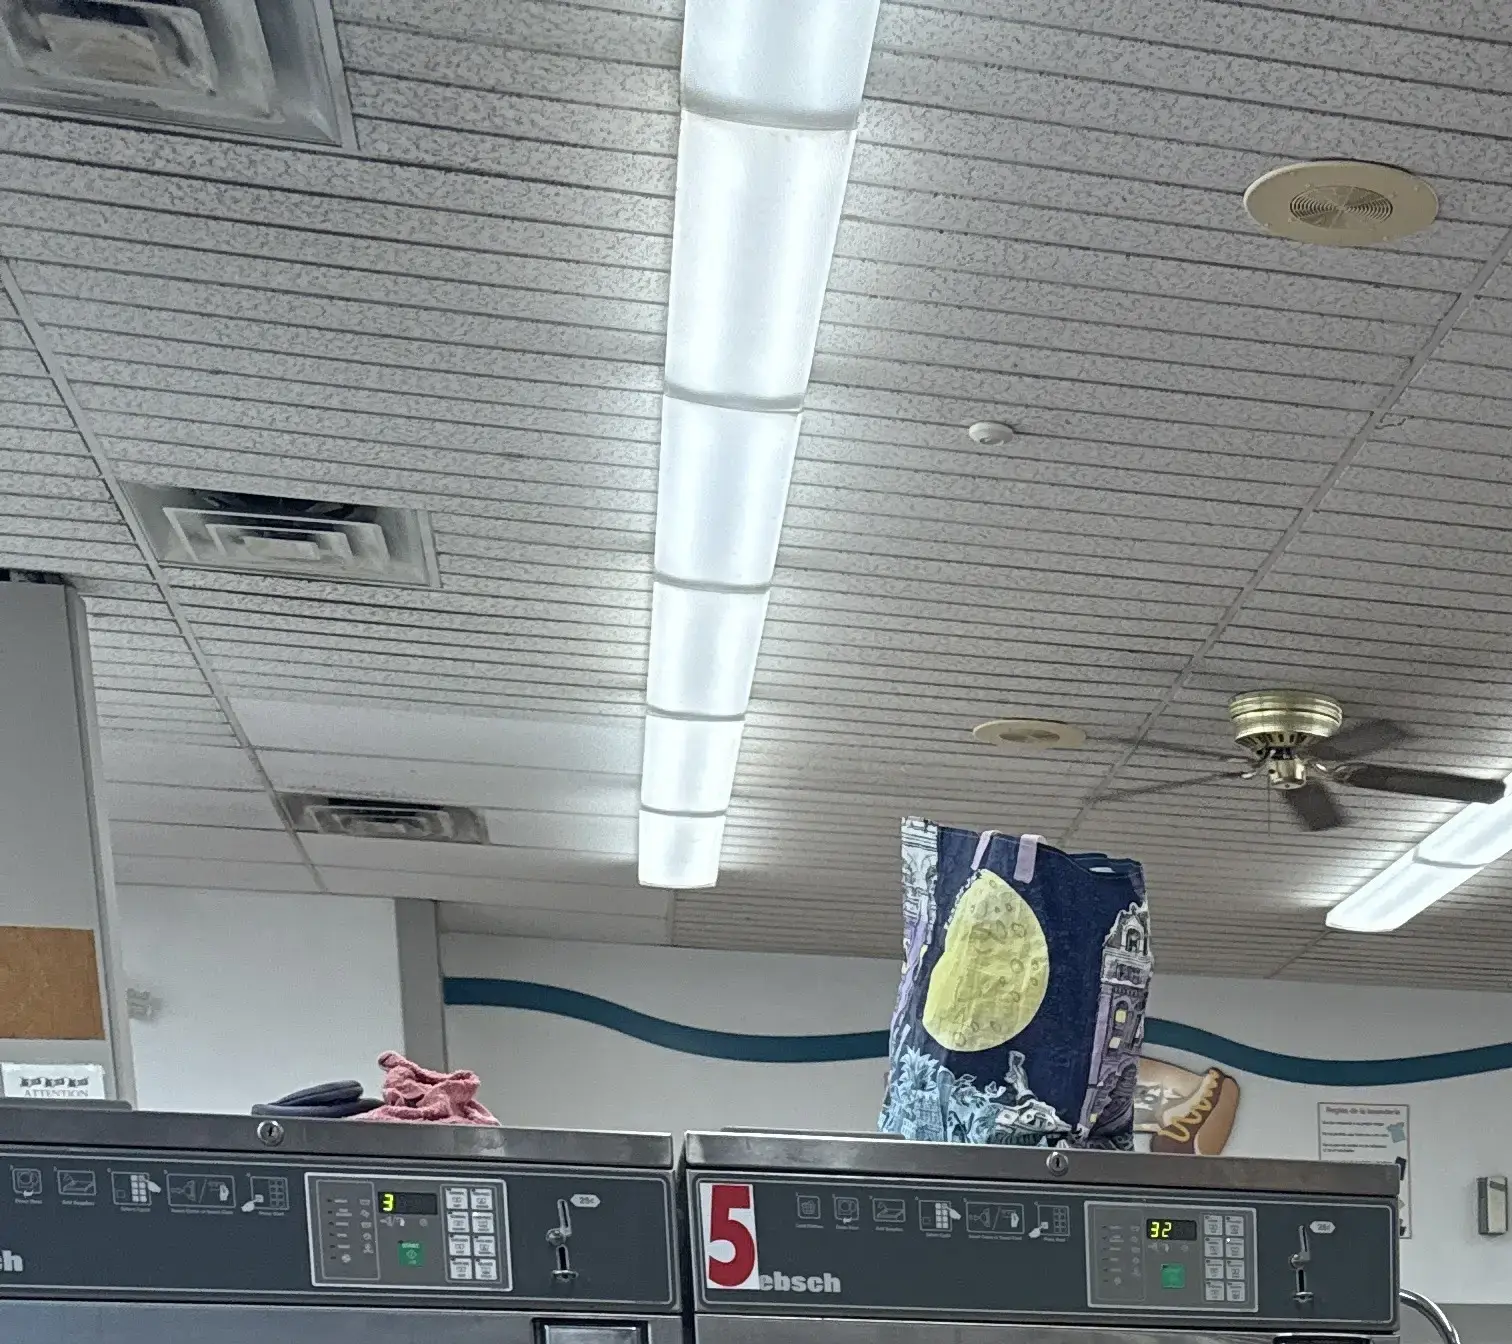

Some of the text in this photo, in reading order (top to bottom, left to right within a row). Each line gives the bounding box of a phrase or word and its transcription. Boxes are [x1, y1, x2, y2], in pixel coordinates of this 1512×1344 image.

[25, 1089, 89, 1097] ATTENTION
[382, 1193, 394, 1212] 3
[708, 1185, 755, 1287] 5
[1150, 1221, 1172, 1238] 32
